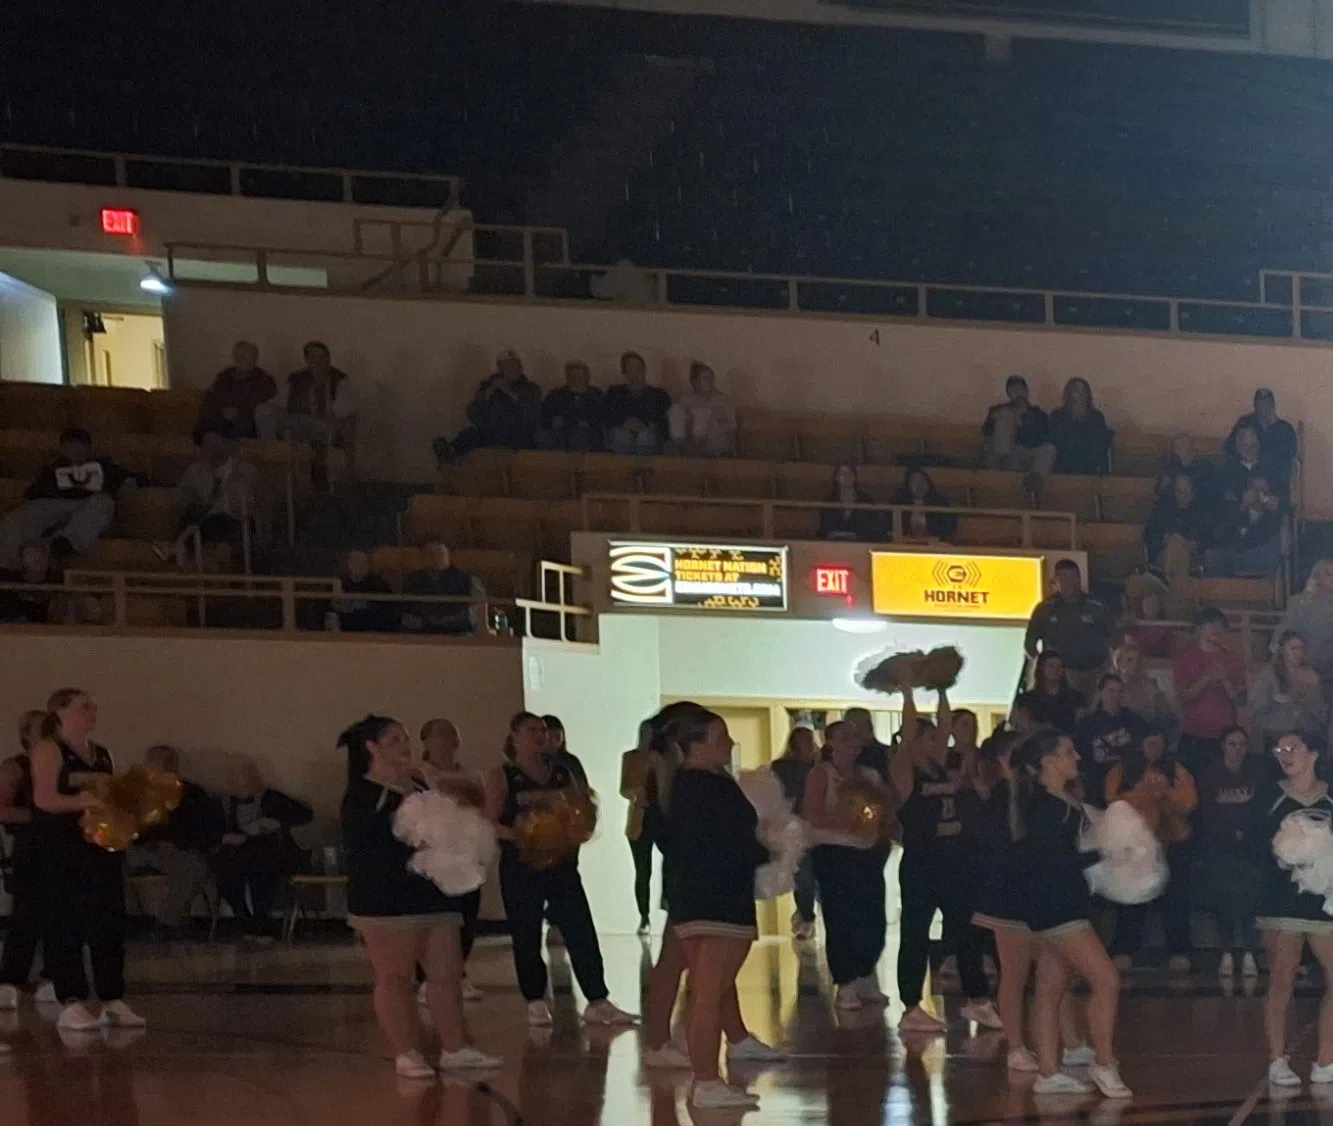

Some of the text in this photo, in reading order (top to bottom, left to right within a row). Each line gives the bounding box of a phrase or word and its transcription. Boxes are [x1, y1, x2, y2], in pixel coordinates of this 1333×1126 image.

[102, 209, 133, 234] EXIT
[869, 327, 880, 346] 4
[723, 561, 767, 574] NATION
[817, 568, 849, 594] EXIT
[924, 589, 990, 604] HORNET
